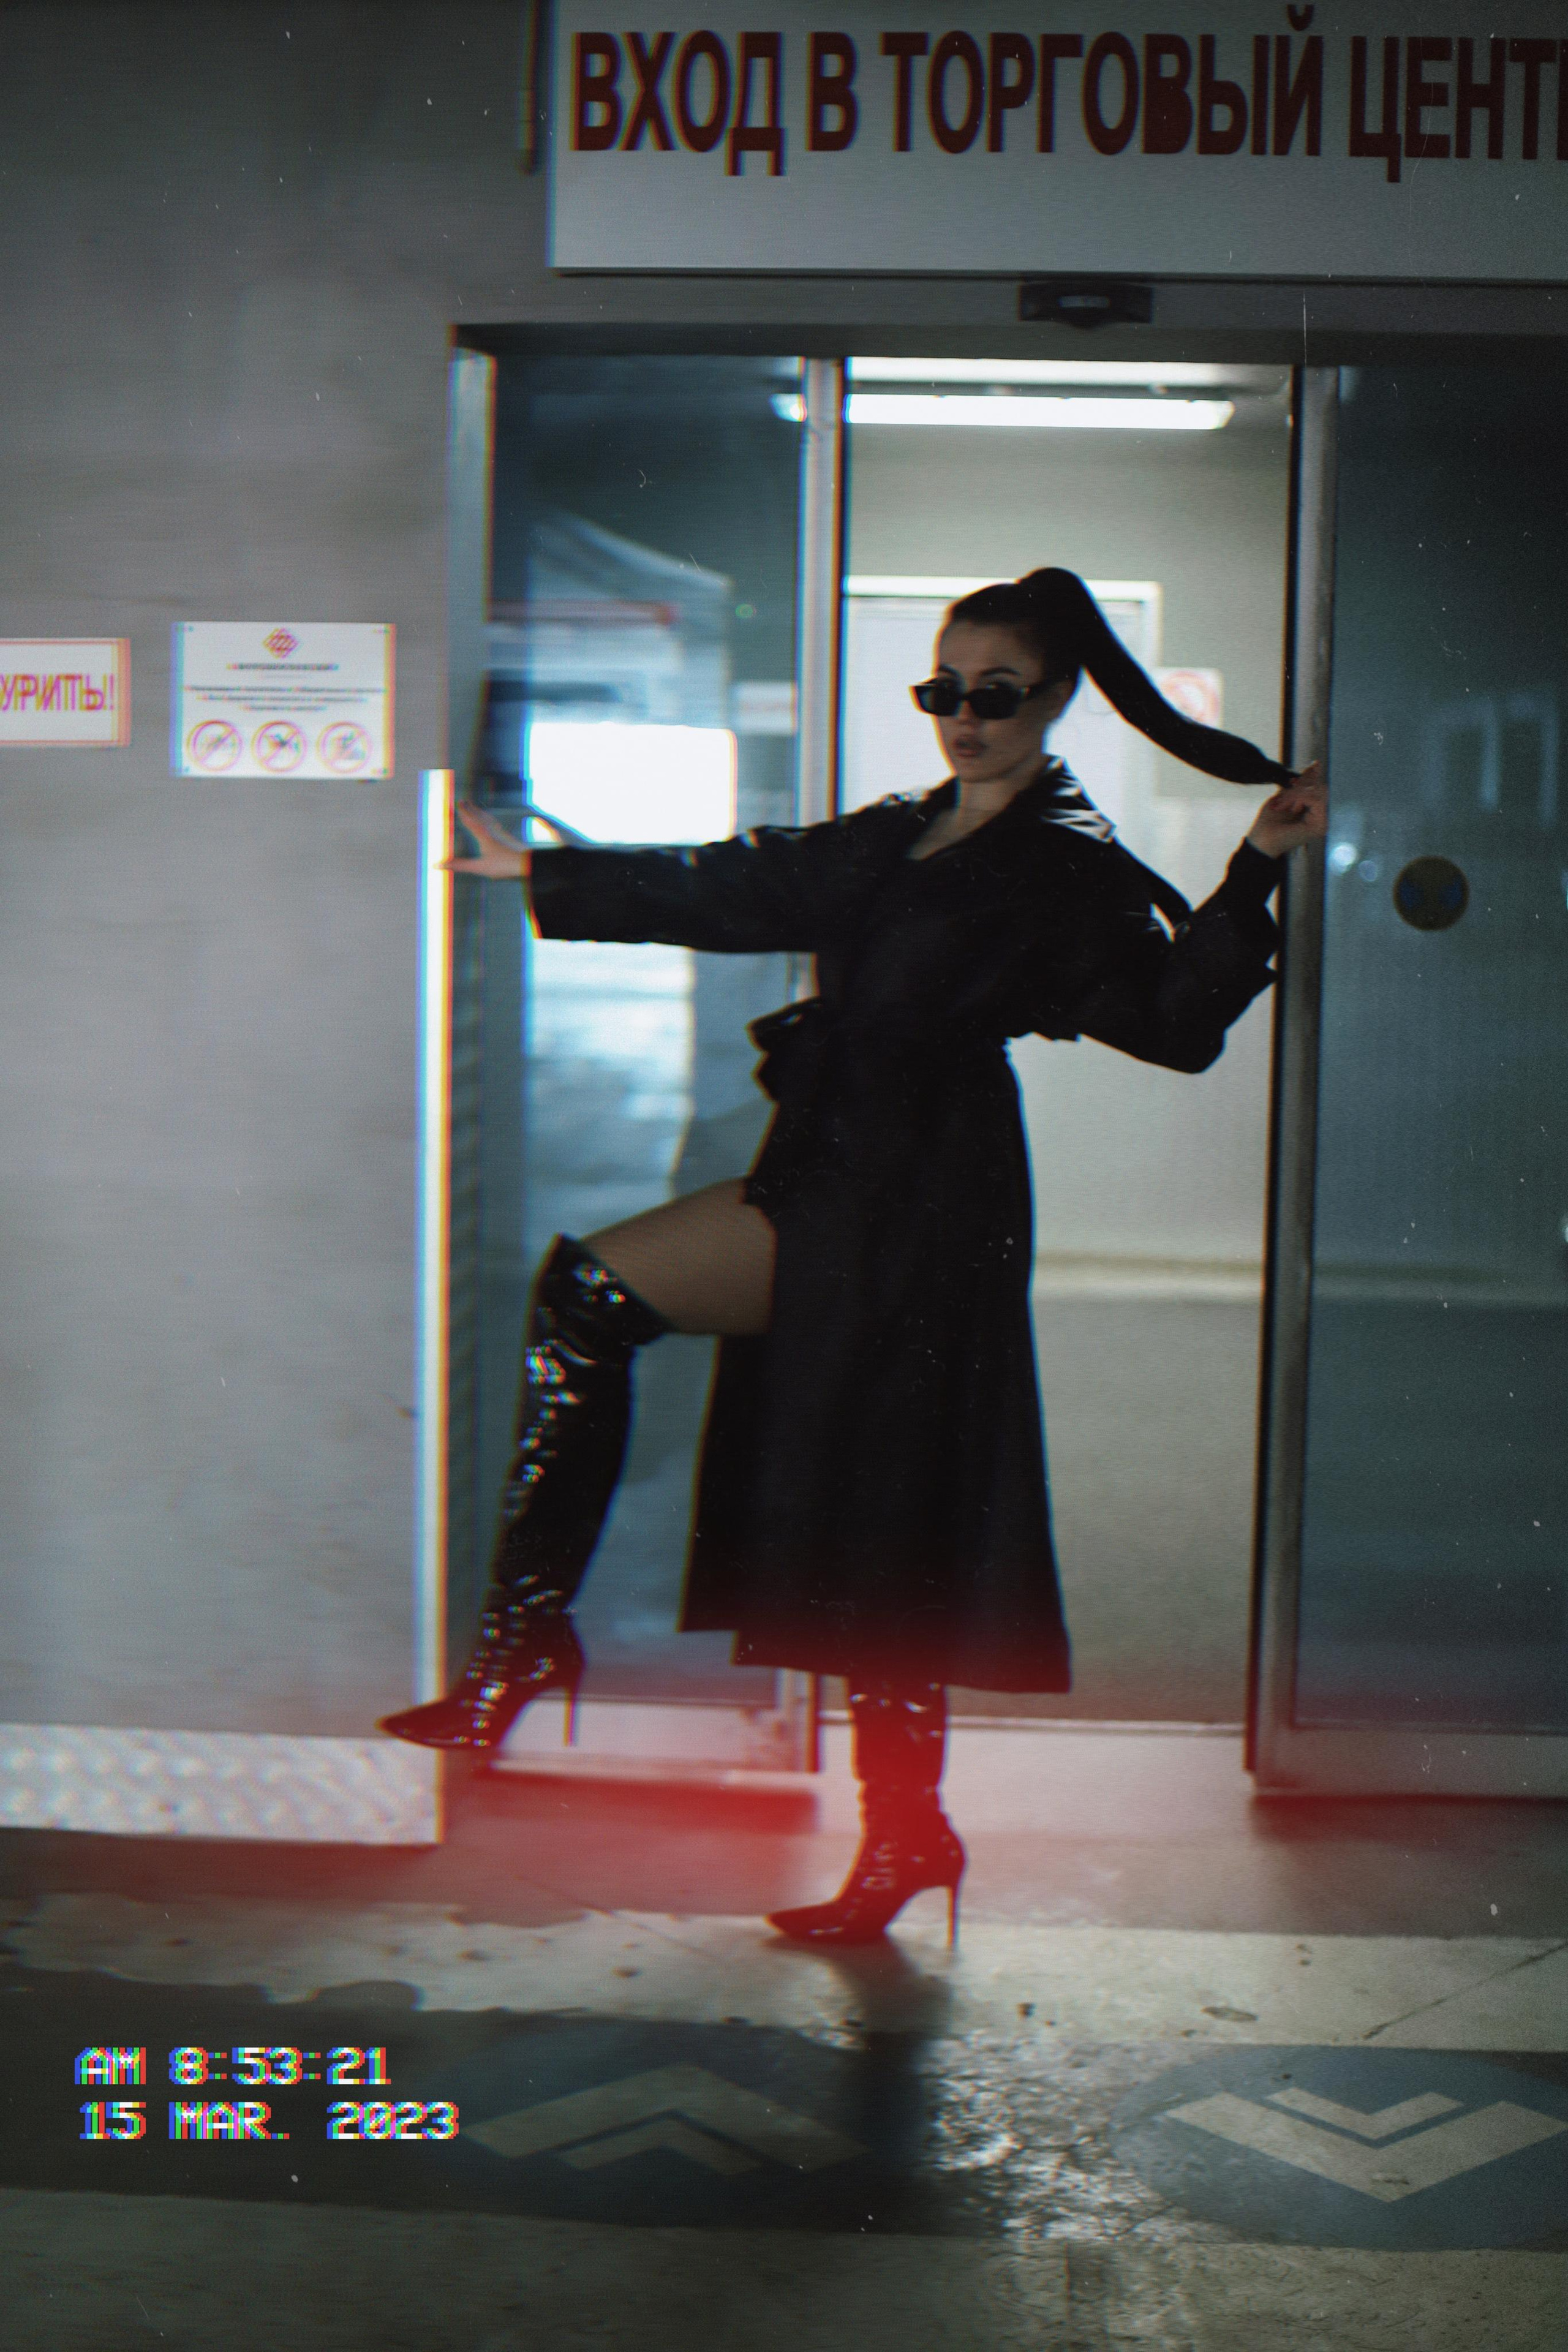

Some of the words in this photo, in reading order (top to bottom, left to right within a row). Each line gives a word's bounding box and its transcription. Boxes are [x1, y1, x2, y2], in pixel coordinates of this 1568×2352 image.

[570, 30, 786, 176] ВХОД
[805, 31, 858, 152] В
[880, 4, 1324, 156] ТОРГОВЫЙ
[1349, 36, 1568, 183] ЦЕНТ
